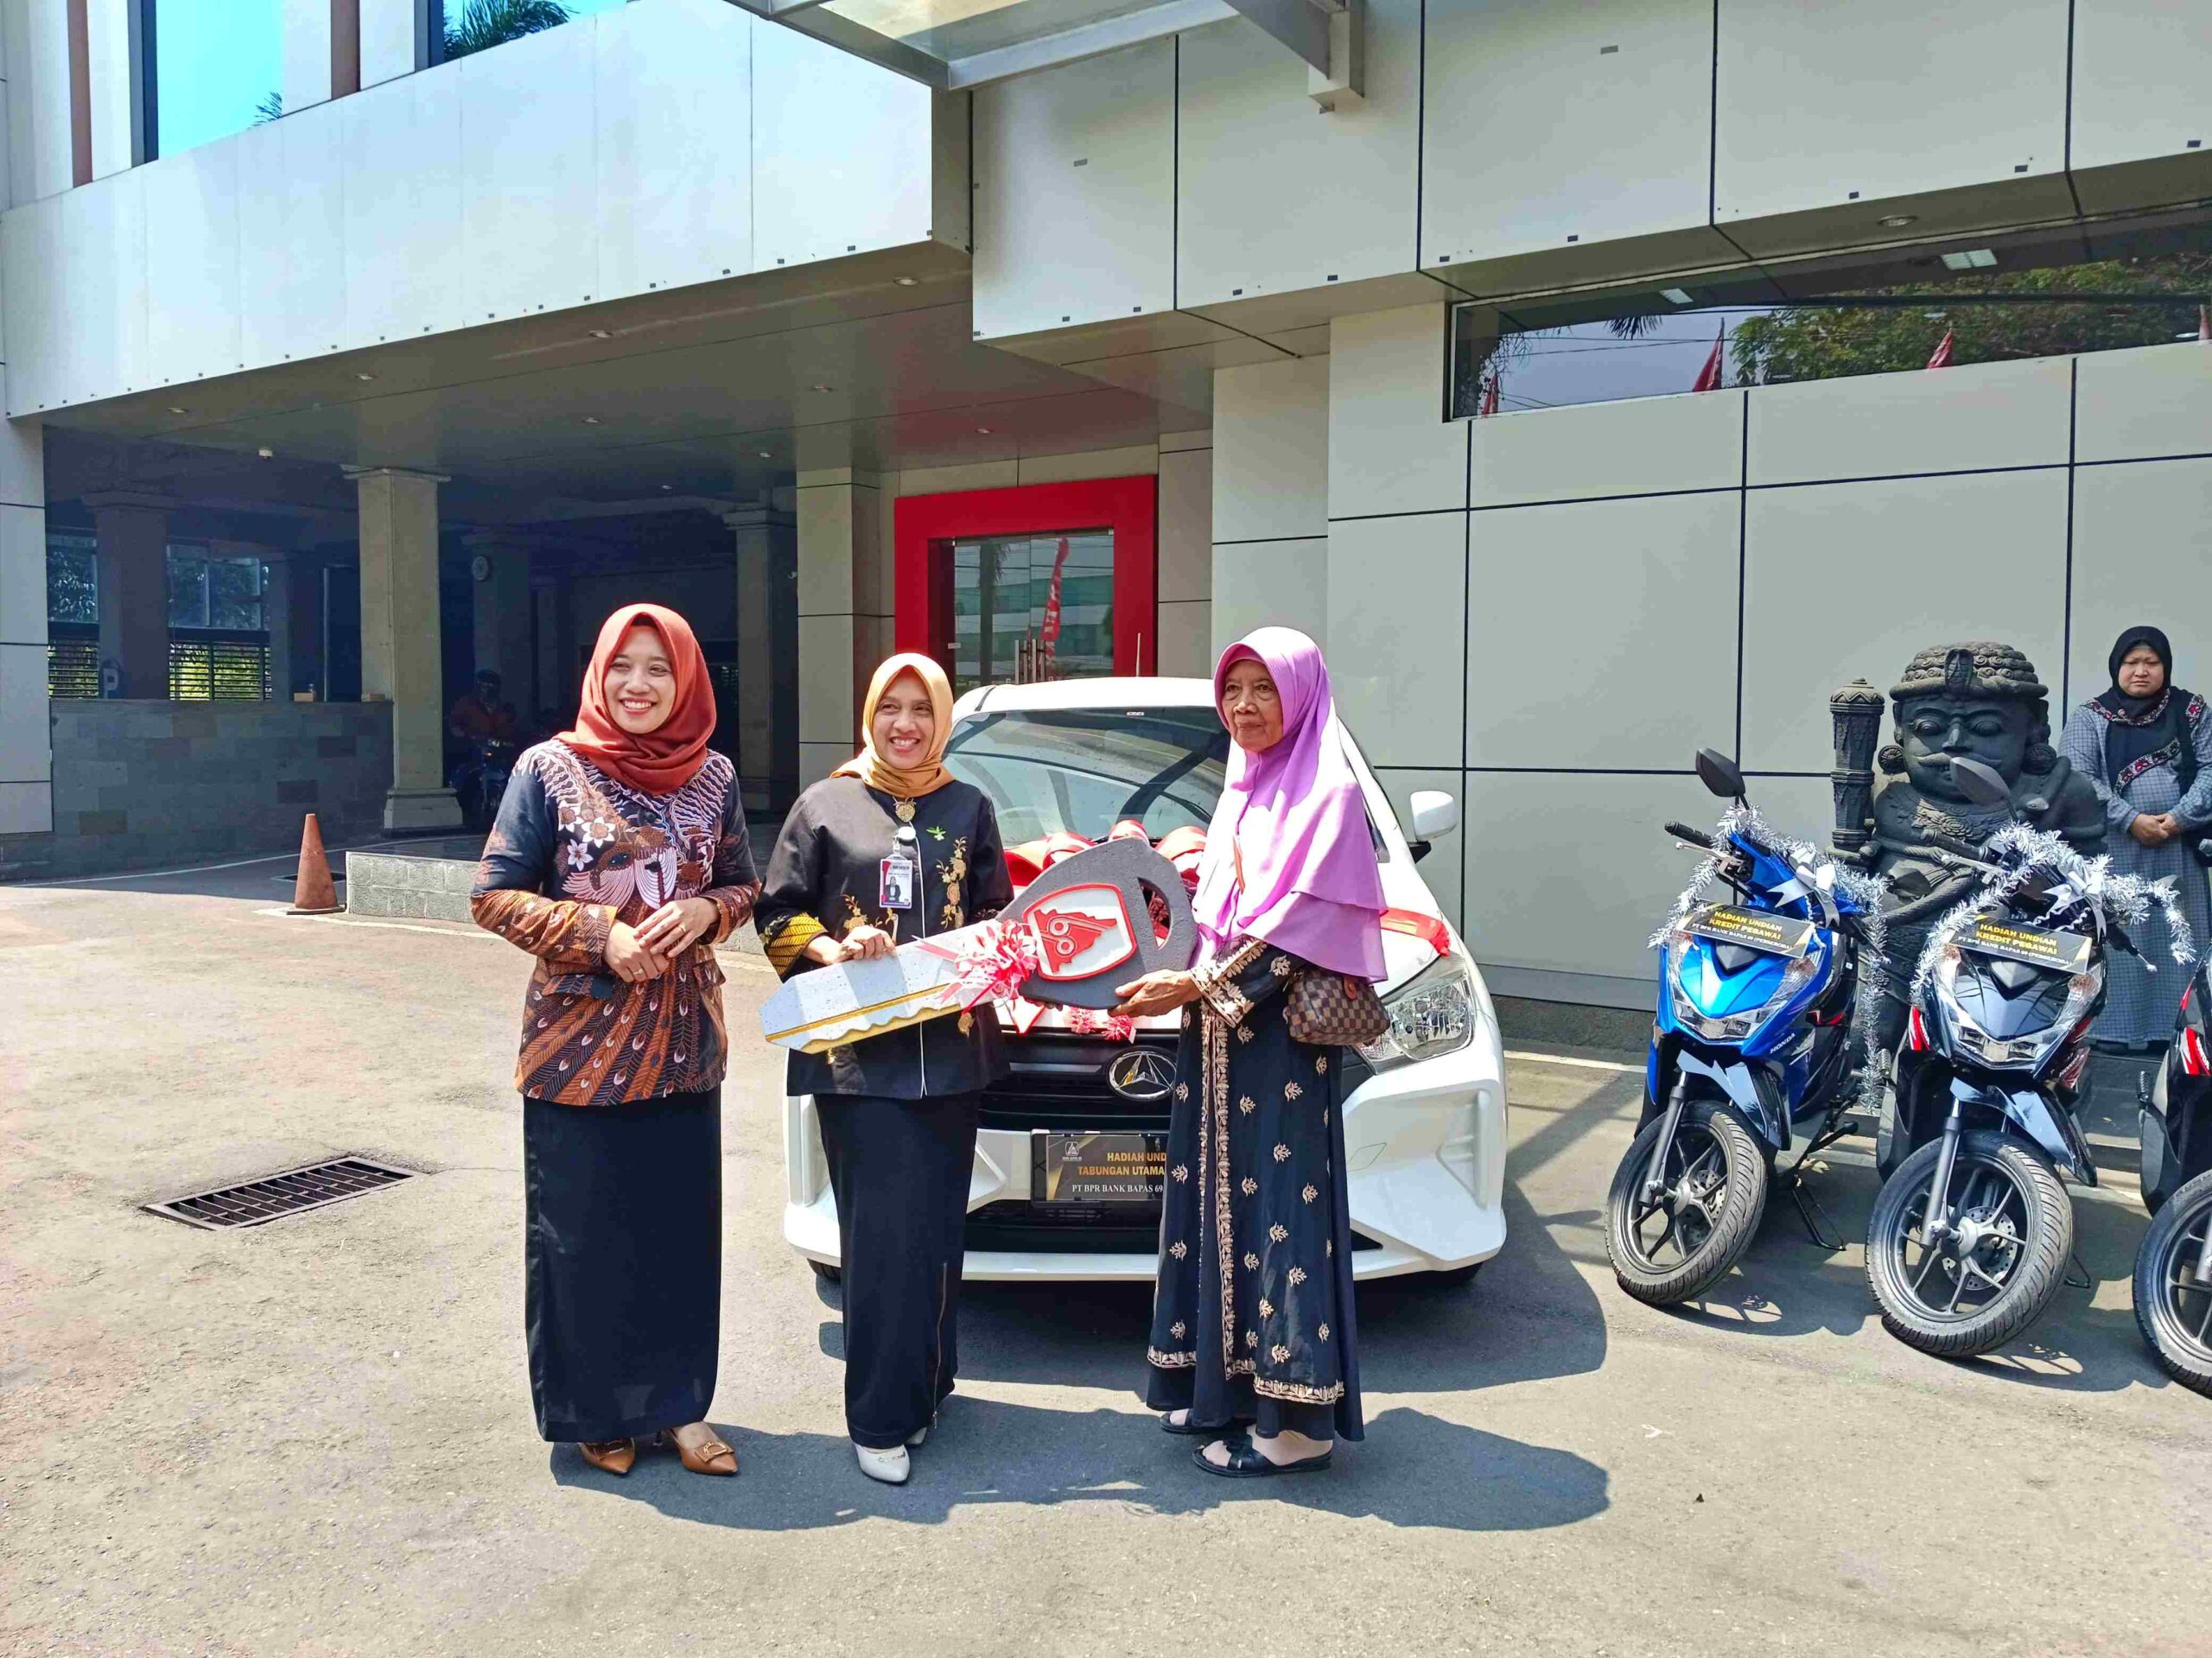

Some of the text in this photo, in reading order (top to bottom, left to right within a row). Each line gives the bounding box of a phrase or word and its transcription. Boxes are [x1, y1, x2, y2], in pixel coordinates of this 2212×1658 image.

[1709, 918, 1782, 940] KREDIT PEGAWAI
[1749, 918, 1783, 931] UNDIAN
[1980, 924, 2057, 946] HADIAH UNDIAN
[1975, 931, 2058, 955] KREDIT PEGAWAI
[1769, 1032, 1796, 1054] HONDA
[1107, 1152, 1167, 1162] HADIAH UND
[1077, 1166, 1166, 1176] TABUNGAN UTAMA
